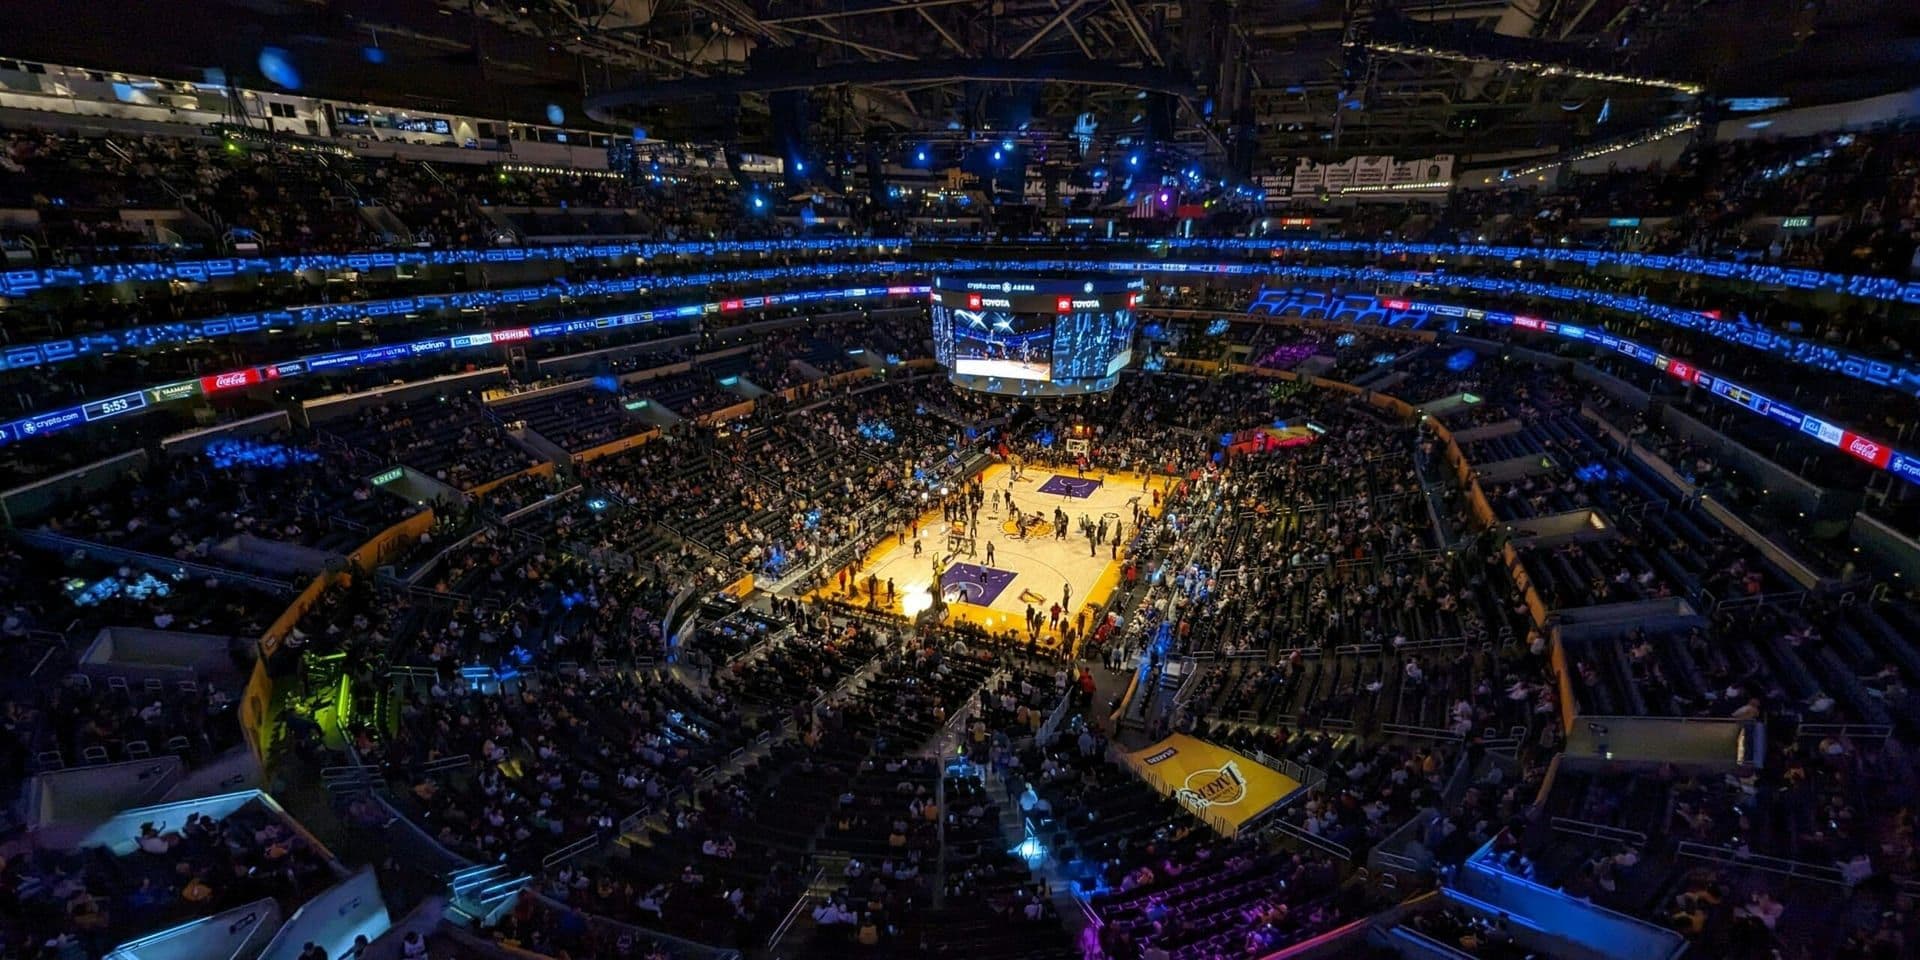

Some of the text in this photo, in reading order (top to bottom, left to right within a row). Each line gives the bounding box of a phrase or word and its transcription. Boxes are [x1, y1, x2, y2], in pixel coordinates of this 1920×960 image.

[967, 282, 1035, 291] crypto.com ARENA
[981, 298, 1011, 307] TOYOTA
[1072, 299, 1100, 308] TOYOTA
[494, 329, 530, 341] TOSHIBA
[386, 347, 406, 356] ULTRA
[411, 341, 446, 352] Spectrum
[278, 364, 301, 373] TOYOTA
[102, 399, 128, 414] 5:53
[36, 412, 79, 428] crypto.com
[1805, 420, 1819, 432] UCLA
